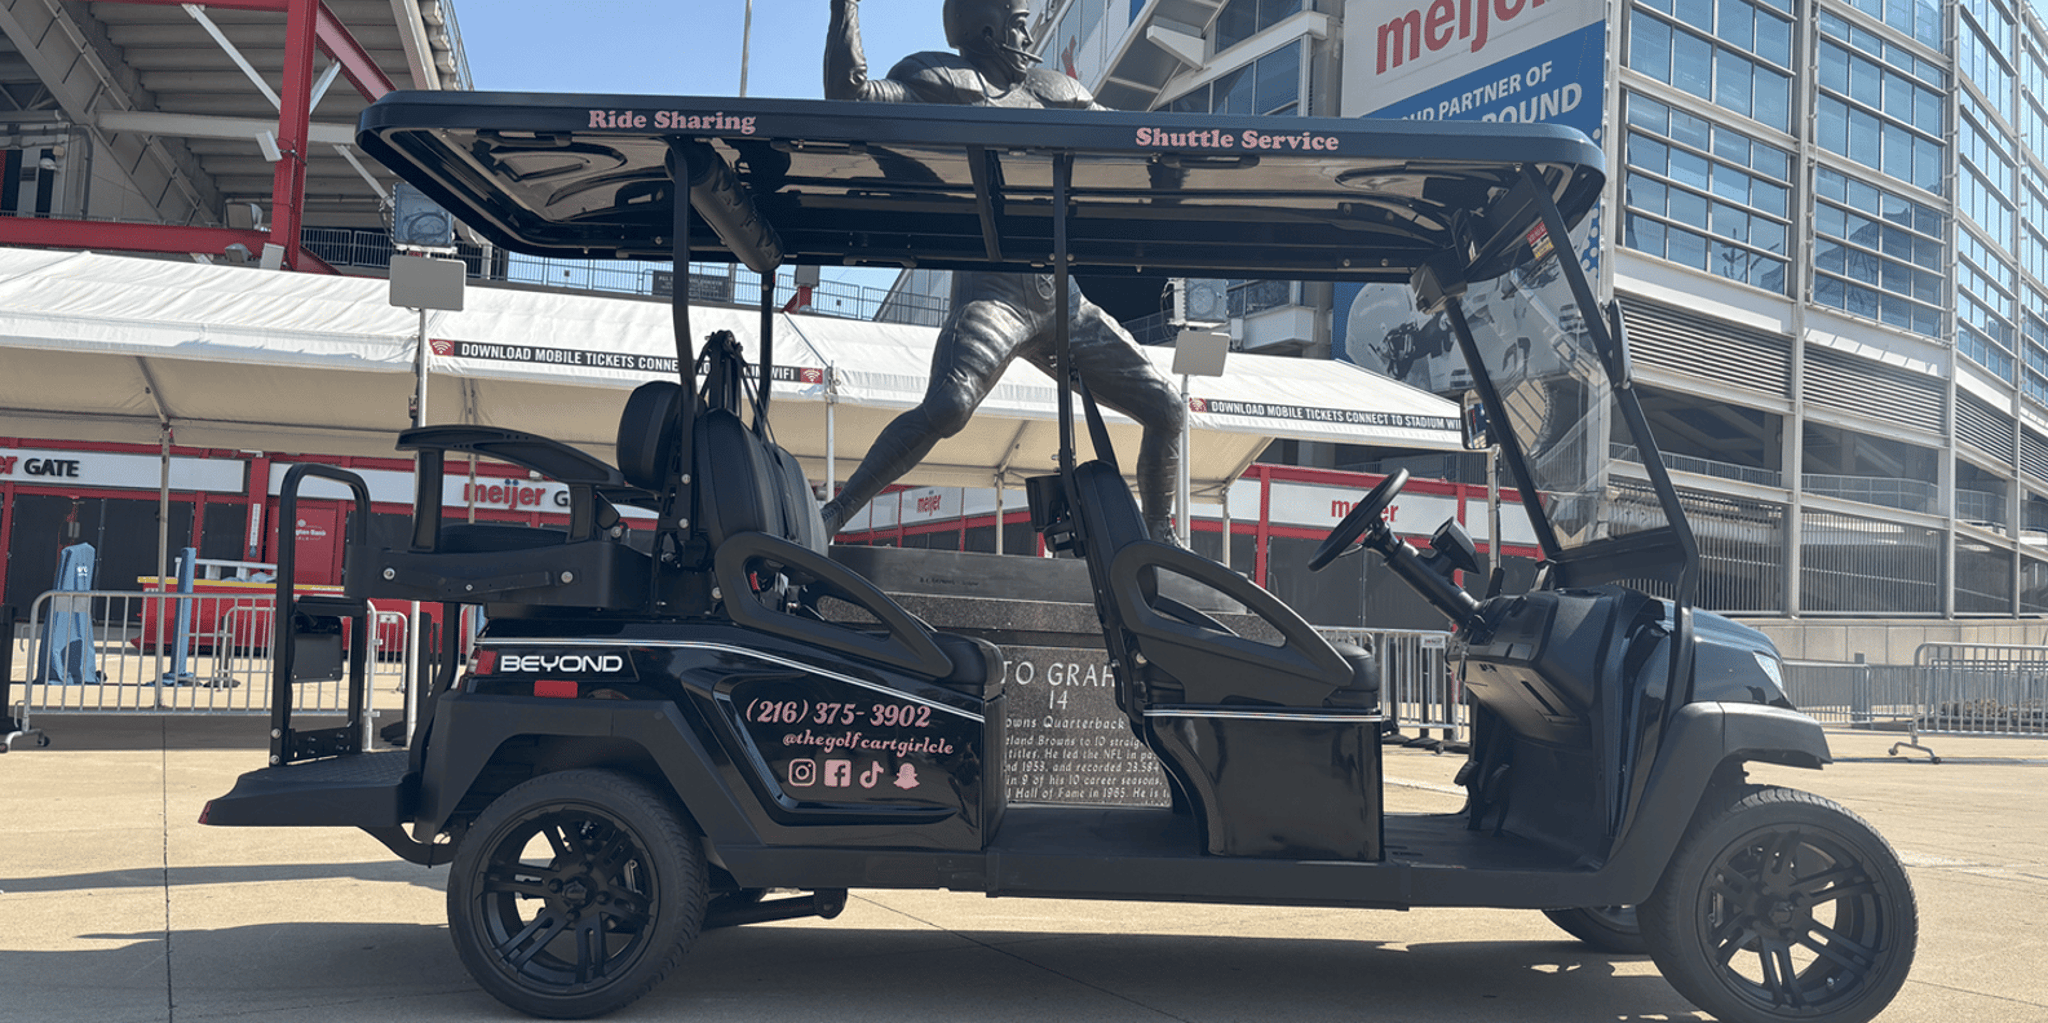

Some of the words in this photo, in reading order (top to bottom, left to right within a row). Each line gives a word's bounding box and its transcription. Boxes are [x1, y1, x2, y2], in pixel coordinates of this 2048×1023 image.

[1439, 74, 1521, 120] PARTNER
[1526, 61, 1552, 88] OF
[588, 110, 648, 129] Ride
[654, 110, 757, 135] Sharing
[1136, 127, 1235, 148] Shuttle
[1241, 130, 1339, 151] Service
[461, 343, 532, 360] DOWNLOAD
[534, 348, 582, 364] MOBILE
[585, 352, 635, 368] TICKETS
[1211, 401, 1265, 416] DOWNLOAD
[1266, 405, 1303, 419] MOBILE
[1305, 408, 1343, 423] TICKETS
[1345, 411, 1389, 425] CONNECT
[1391, 414, 1403, 426] TO
[1405, 415, 1445, 429] STADIUM
[24, 458, 80, 477] GATE
[464, 478, 546, 509] meijer
[500, 655, 624, 673] BEYOND
[1049, 690, 1068, 710] 14
[746, 698, 809, 724] (216)
[870, 704, 932, 728] 3902
[1043, 715, 1126, 730] Quarterback
[782, 729, 954, 758] @thegolfcartgirlcle
[1038, 735, 1077, 747] Browns
[1094, 735, 1107, 747] 10
[1044, 748, 1059, 759] He
[1062, 748, 1079, 759] led
[1082, 748, 1099, 759] the
[1103, 748, 1123, 760] NFL
[1126, 749, 1138, 760] in
[1052, 761, 1073, 772] and
[1075, 761, 1123, 773] recorded
[1021, 773, 1029, 785] 9
[1032, 774, 1045, 788] of
[1048, 774, 1065, 785] his
[1068, 774, 1080, 785] 10
[1083, 776, 1117, 786] career
[1121, 776, 1163, 786] seasons.
[1015, 787, 1038, 799] Hall
[1041, 787, 1054, 800] of
[1057, 787, 1085, 798] Fame
[1088, 787, 1100, 798] in
[1132, 787, 1146, 798] He
[1149, 787, 1159, 798] is
